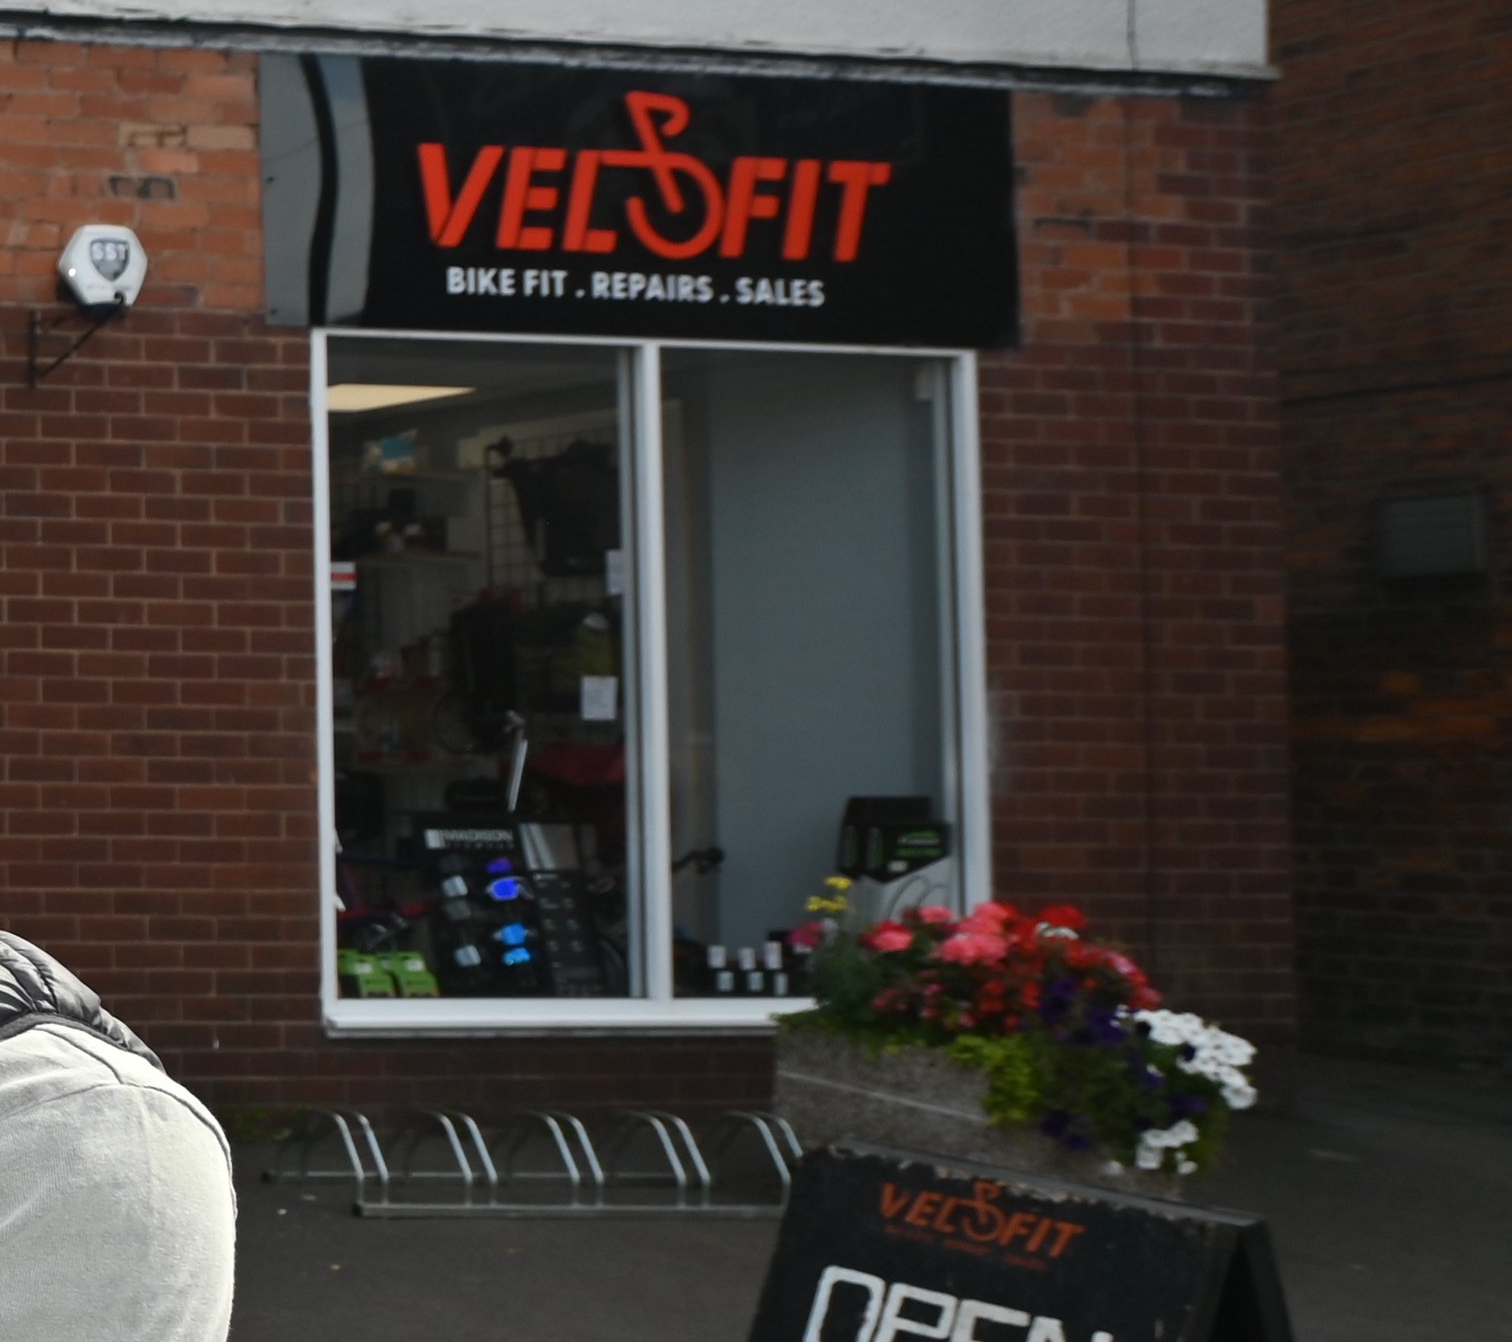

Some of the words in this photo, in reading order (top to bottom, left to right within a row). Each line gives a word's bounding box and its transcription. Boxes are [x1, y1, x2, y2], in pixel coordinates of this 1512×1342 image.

[417, 91, 892, 261] VELOFIT
[446, 266, 517, 296] BIKE
[591, 272, 714, 303] REPAIRS
[735, 276, 826, 307] SALES
